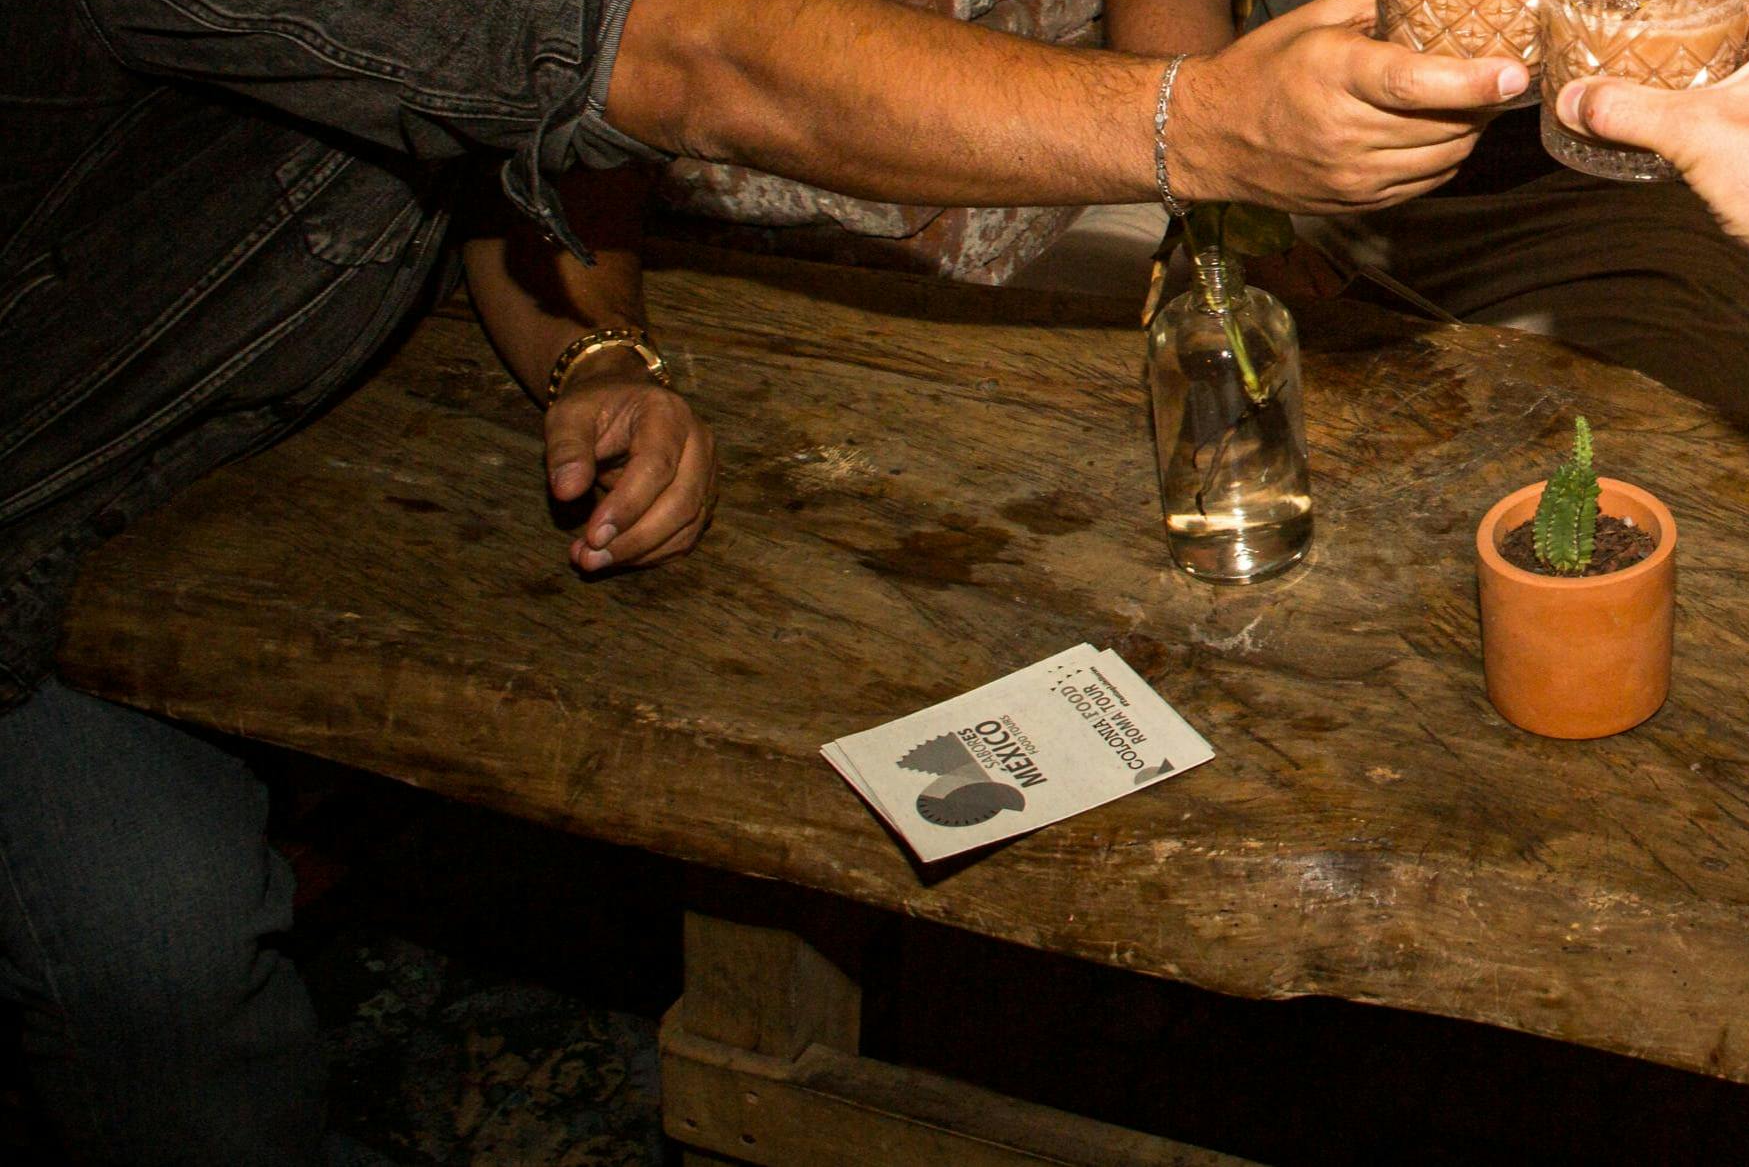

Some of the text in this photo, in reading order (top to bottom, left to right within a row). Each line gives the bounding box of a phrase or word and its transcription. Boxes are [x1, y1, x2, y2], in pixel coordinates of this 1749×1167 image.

[1018, 735, 1040, 755] FOOD
[1060, 685, 1145, 770] COLONIA FOOD
[1083, 683, 1148, 745] ROMA TOUR
[957, 728, 1000, 769] SABORES
[975, 720, 1048, 788] MÉXICO
